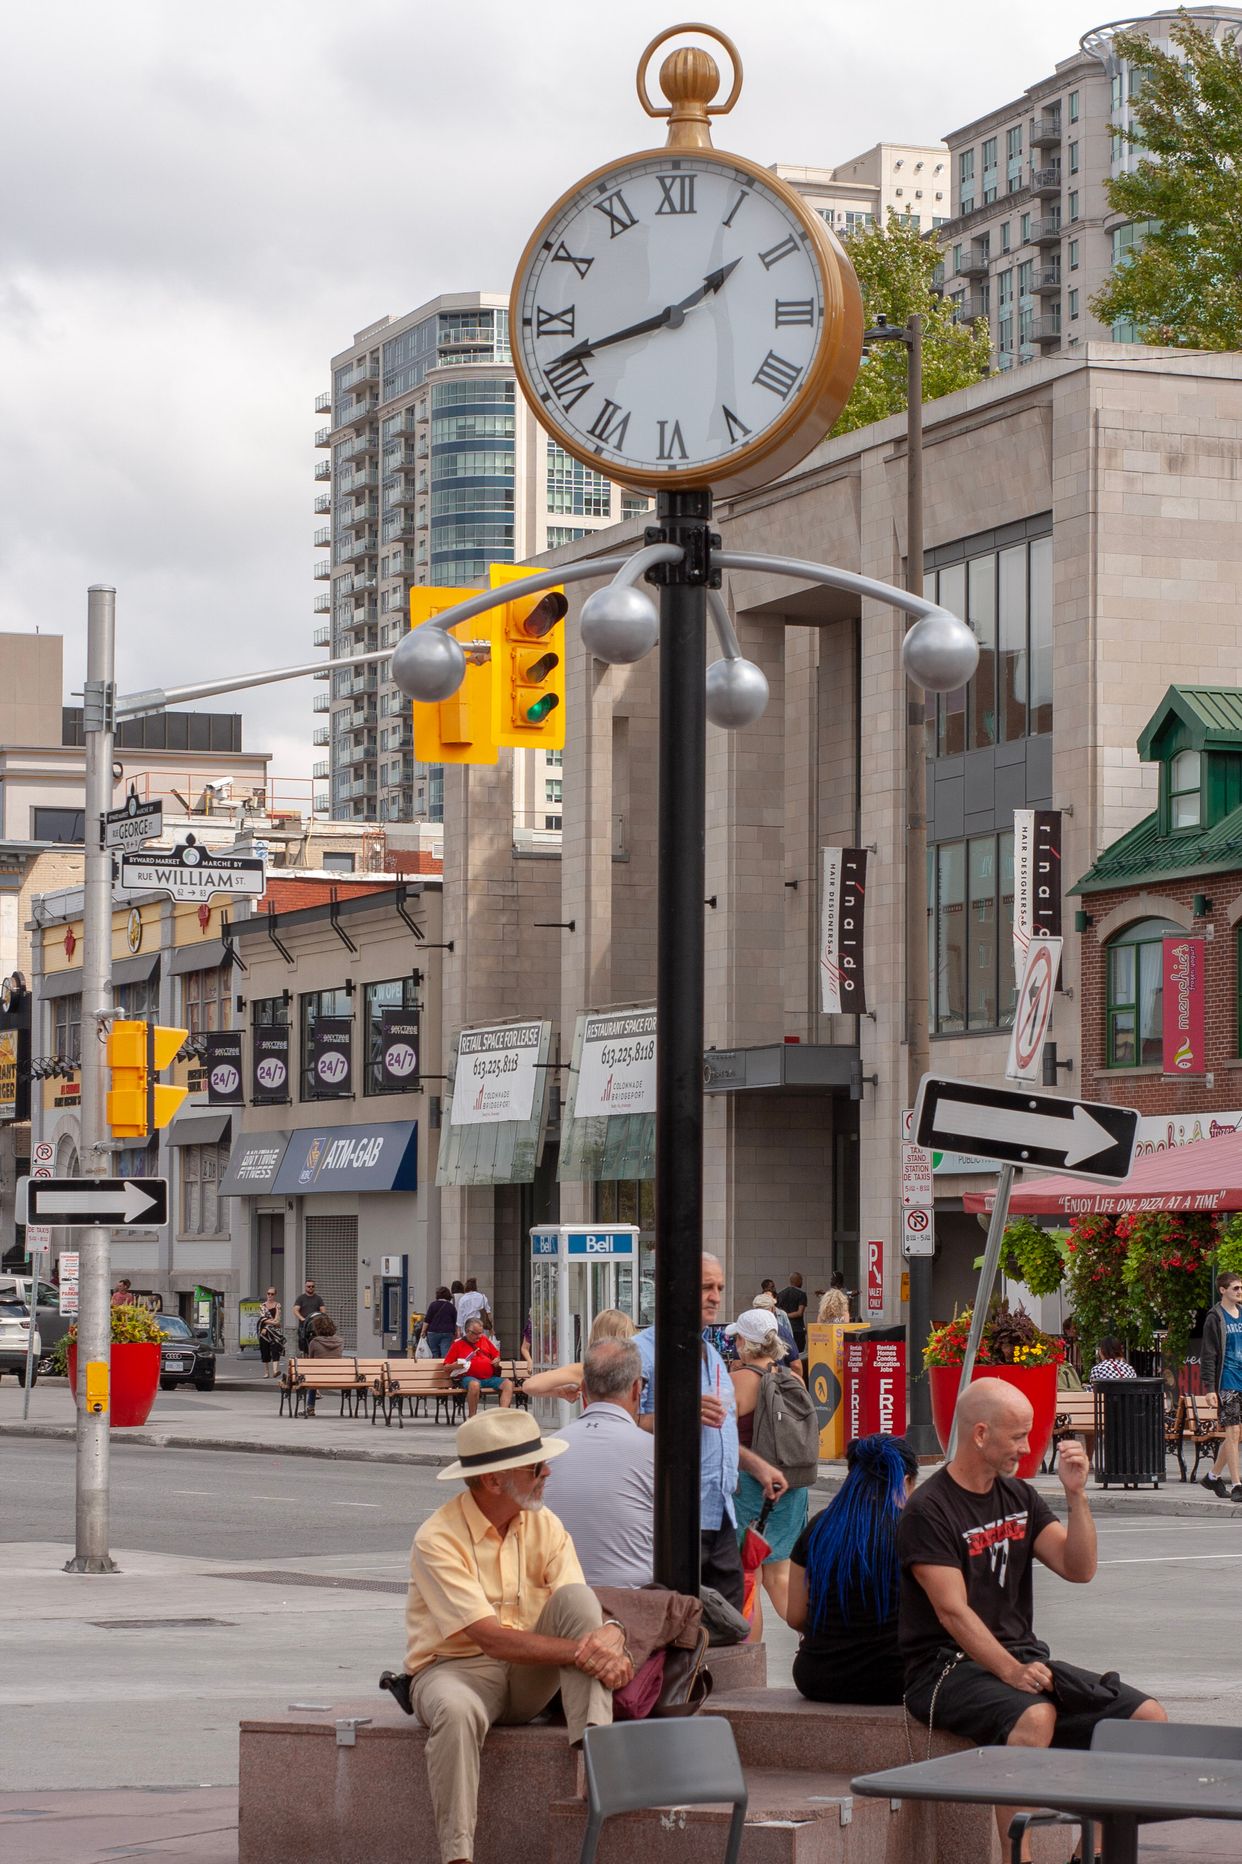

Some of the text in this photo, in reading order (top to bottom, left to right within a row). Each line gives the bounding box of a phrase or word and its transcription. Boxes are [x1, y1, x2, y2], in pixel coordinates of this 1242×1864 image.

[655, 174, 698, 215] XII
[593, 189, 639, 239] XI
[551, 240, 594, 280] X
[758, 233, 801, 271] II
[537, 304, 575, 338] IX
[775, 297, 814, 329] III
[586, 398, 631, 452] VII
[722, 404, 752, 445] V
[656, 419, 689, 460] VI
[119, 818, 148, 840] GEORGE
[138, 872, 153, 880] RUE
[155, 869, 234, 888] WILLIAM
[844, 863, 858, 990] rinaldo
[462, 1028, 538, 1052] RETAIL SPACE FOR LEASE
[586, 1016, 657, 1038] RESTAURANT SPACE FOR
[320, 1058, 346, 1076] 24/7
[388, 1050, 414, 1070] 24/7
[473, 1053, 518, 1079] 613.225.8113
[601, 1040, 654, 1068] 613.225.8118
[213, 1070, 237, 1088] 24/7
[260, 1064, 284, 1082] 24/7
[322, 1137, 384, 1170] ATM-GAB
[1094, 1195, 1115, 1212] LIFE
[1116, 1199, 1138, 1212] ONE
[1136, 1197, 1164, 1210] PIZZA
[1166, 1196, 1180, 1209] AT
[1182, 1196, 1191, 1208] A
[540, 1236, 552, 1253] Bell
[586, 1235, 614, 1252] Bell
[870, 1244, 878, 1271] P
